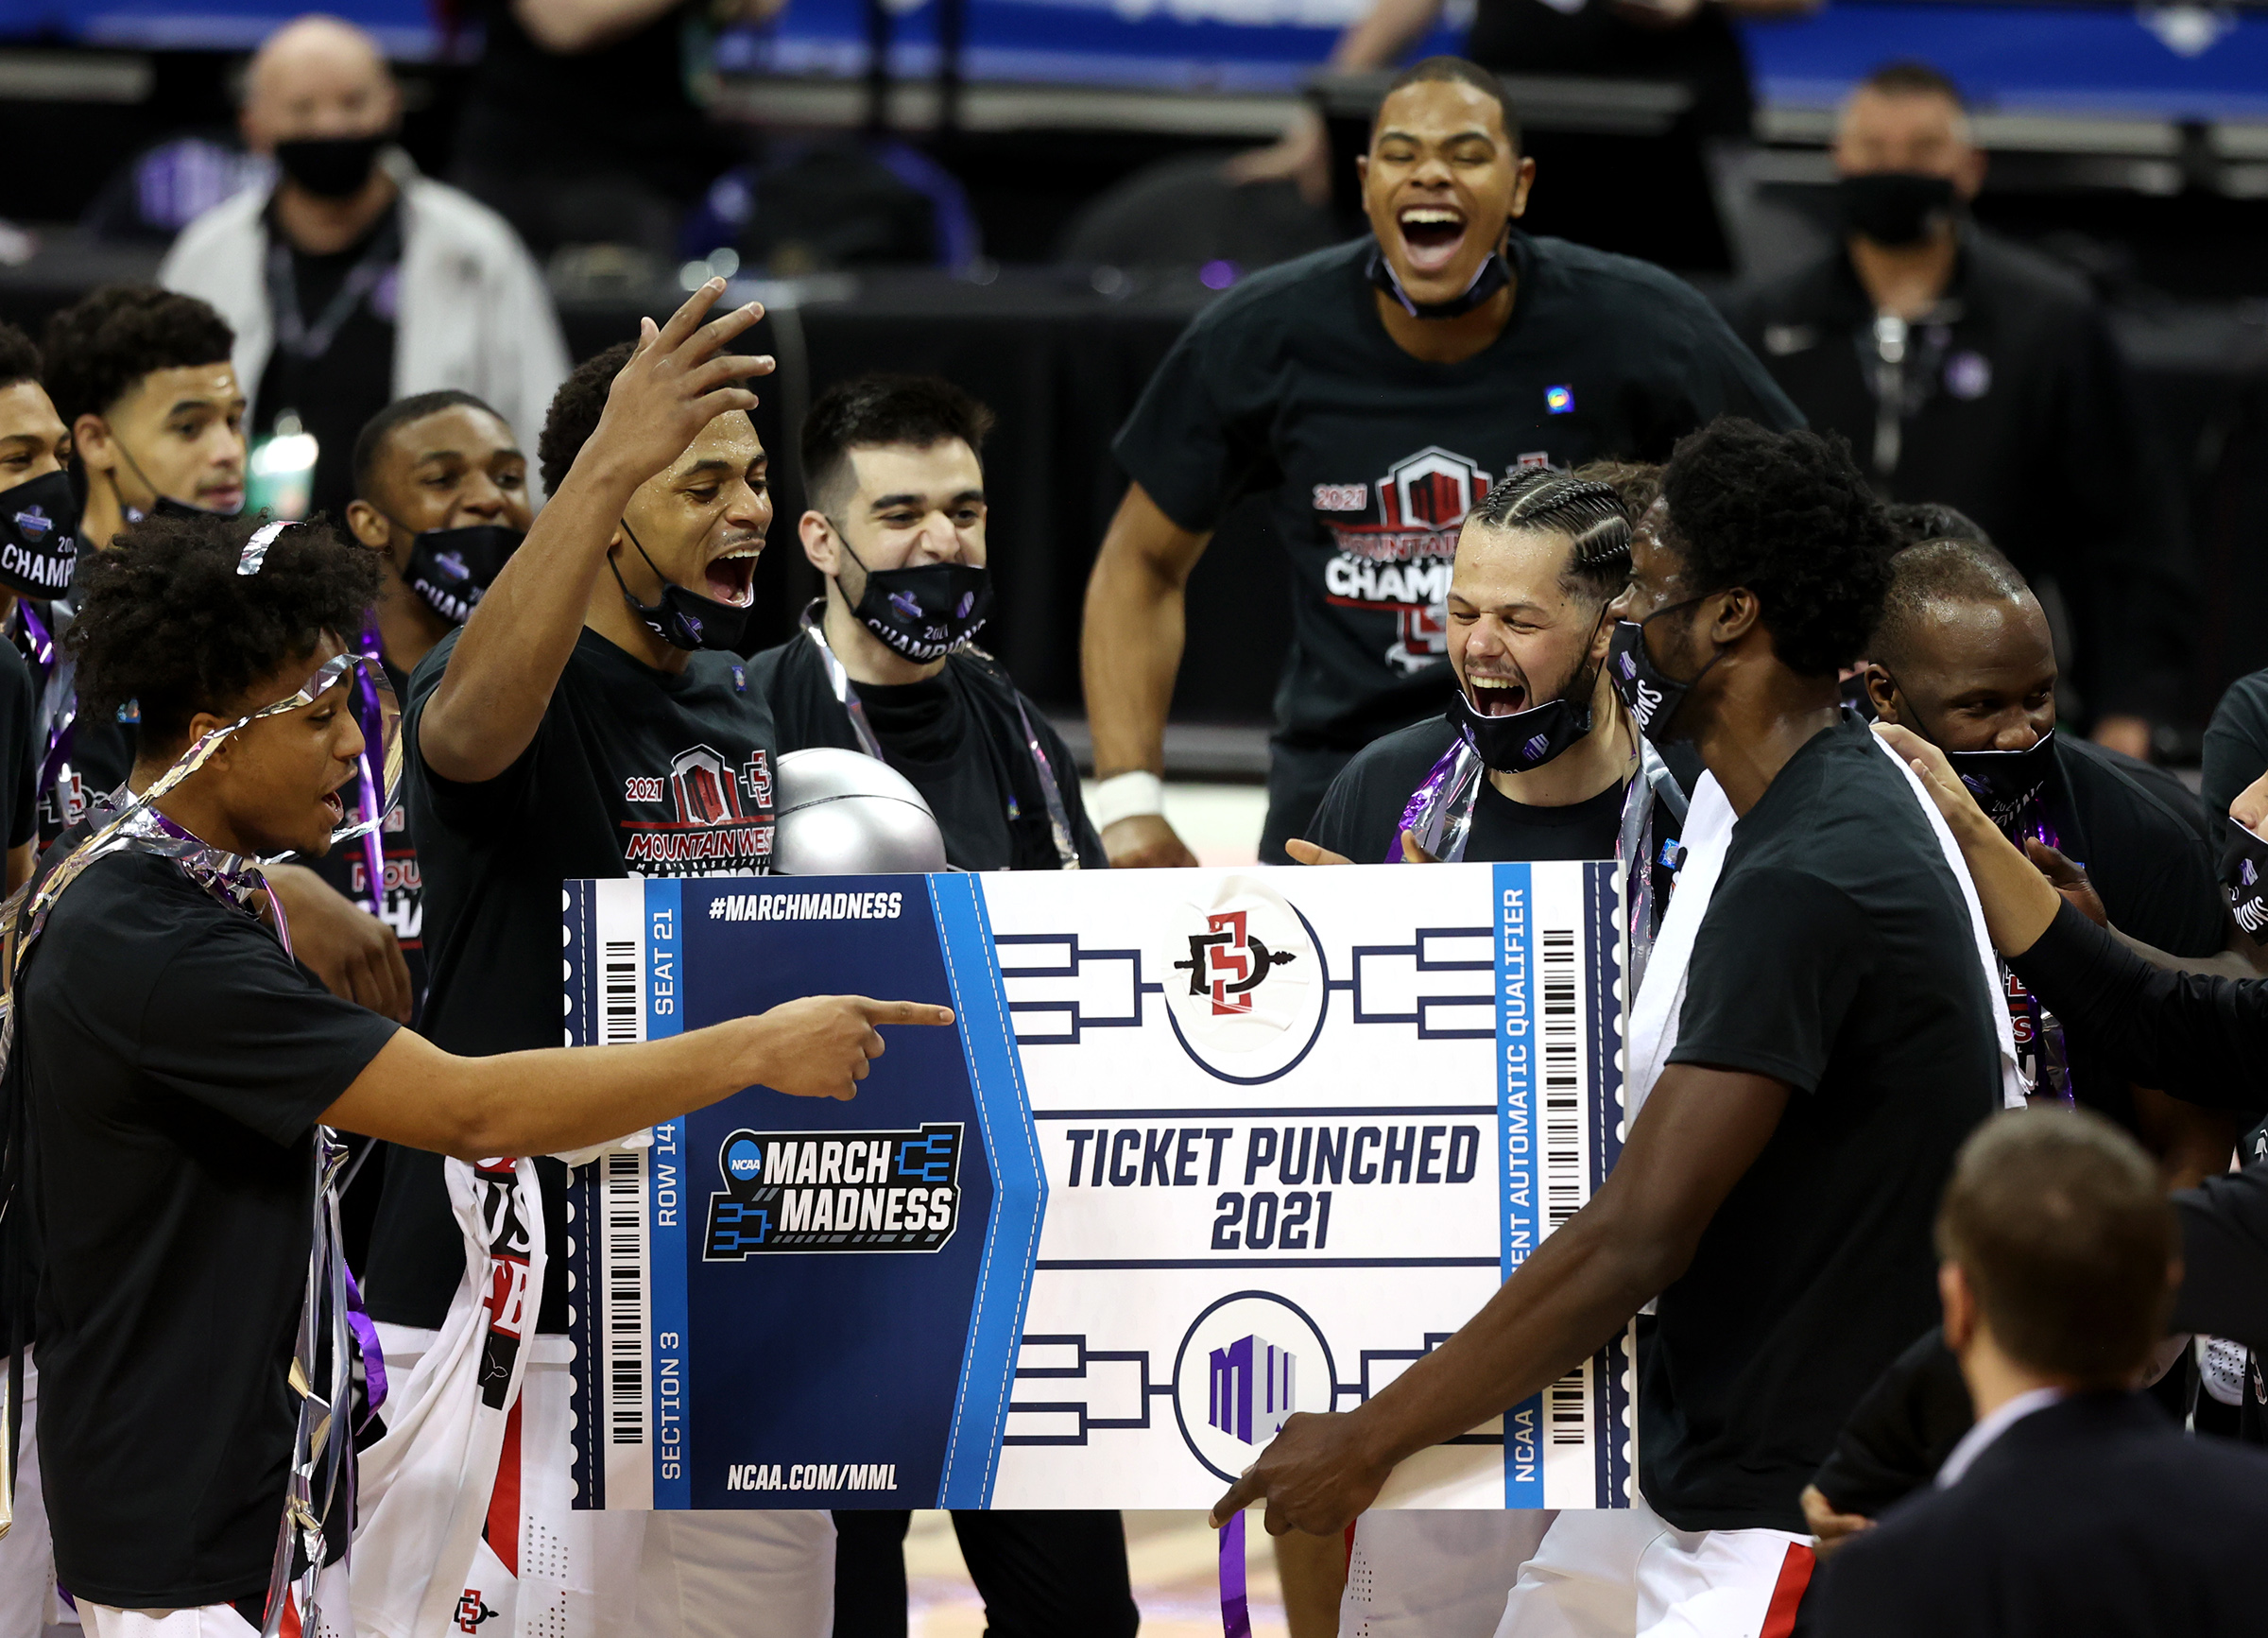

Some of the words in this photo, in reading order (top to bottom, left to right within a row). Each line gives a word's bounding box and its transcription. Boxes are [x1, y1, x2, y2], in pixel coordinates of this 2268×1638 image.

[1313, 484, 1367, 510] 2021
[625, 777, 664, 802] 2021
[625, 830, 737, 862] MOUNTAIN
[636, 861, 685, 872] MEN'S
[653, 908, 673, 940] 21
[709, 892, 902, 922] #MARCHMADNESS
[654, 947, 674, 1015] SEAT
[1503, 889, 1530, 1036] QUALIFIER
[657, 1124, 677, 1155] 14
[1506, 1044, 1530, 1207] AUTOMATIC
[731, 1159, 761, 1171] NCAA
[763, 1140, 888, 1185] MARCH
[1066, 1128, 1233, 1187] TICKET
[1244, 1125, 1480, 1185] PUNCHED
[658, 1164, 678, 1226] ROW
[780, 1188, 953, 1233] MADNESS
[1211, 1191, 1332, 1250] 2021
[1510, 1213, 1531, 1273] ENT
[660, 1332, 679, 1350] 3
[660, 1356, 681, 1480] SECTION
[1514, 1408, 1536, 1482] NCAA
[726, 1463, 898, 1491] NCAA.COM/MML
